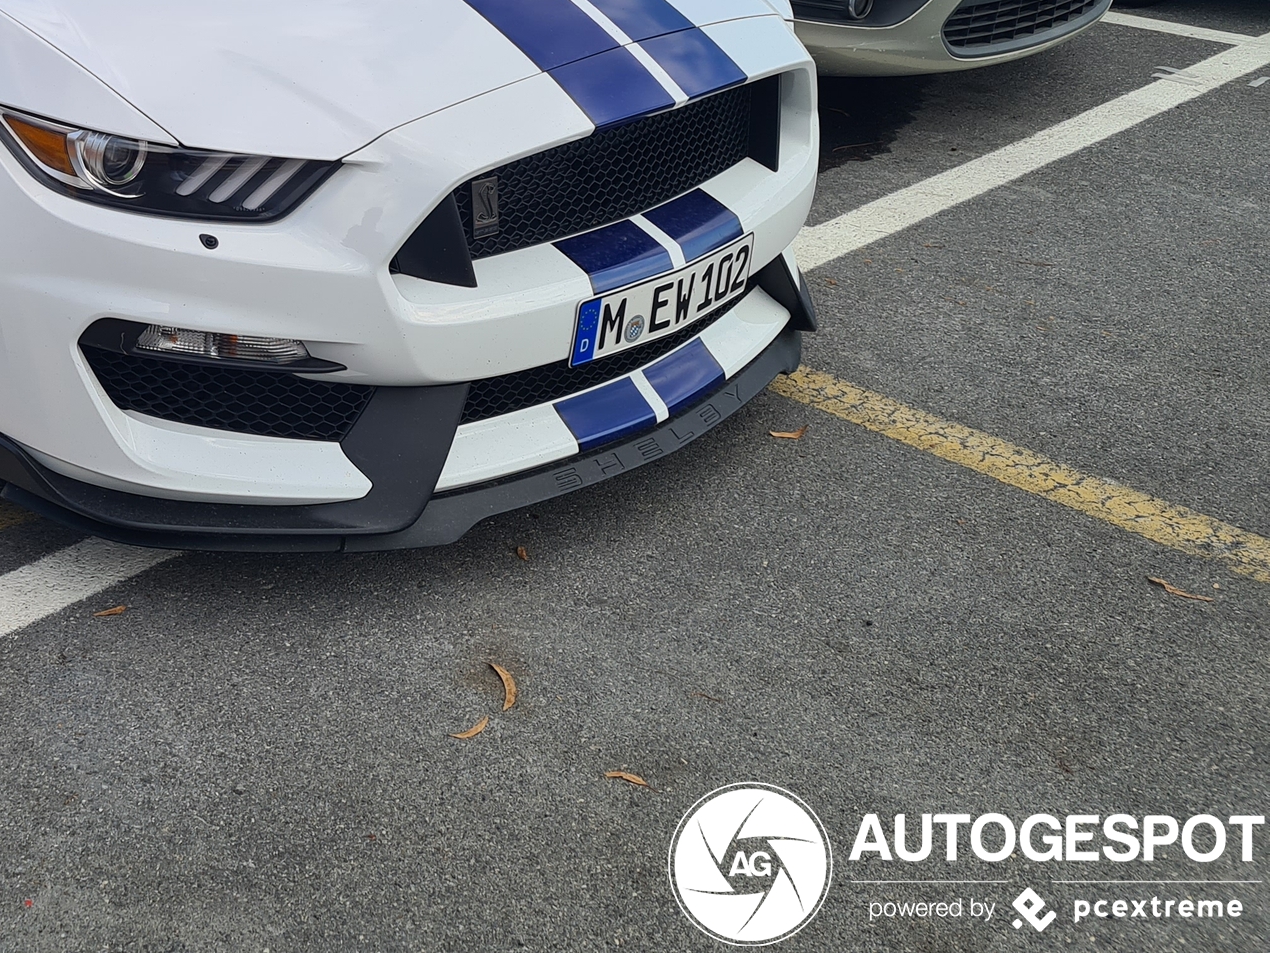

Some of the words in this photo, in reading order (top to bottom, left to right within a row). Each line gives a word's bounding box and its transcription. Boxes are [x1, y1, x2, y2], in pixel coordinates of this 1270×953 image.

[580, 338, 589, 352] D
[598, 298, 628, 350] M
[552, 383, 743, 493] SHELBY
